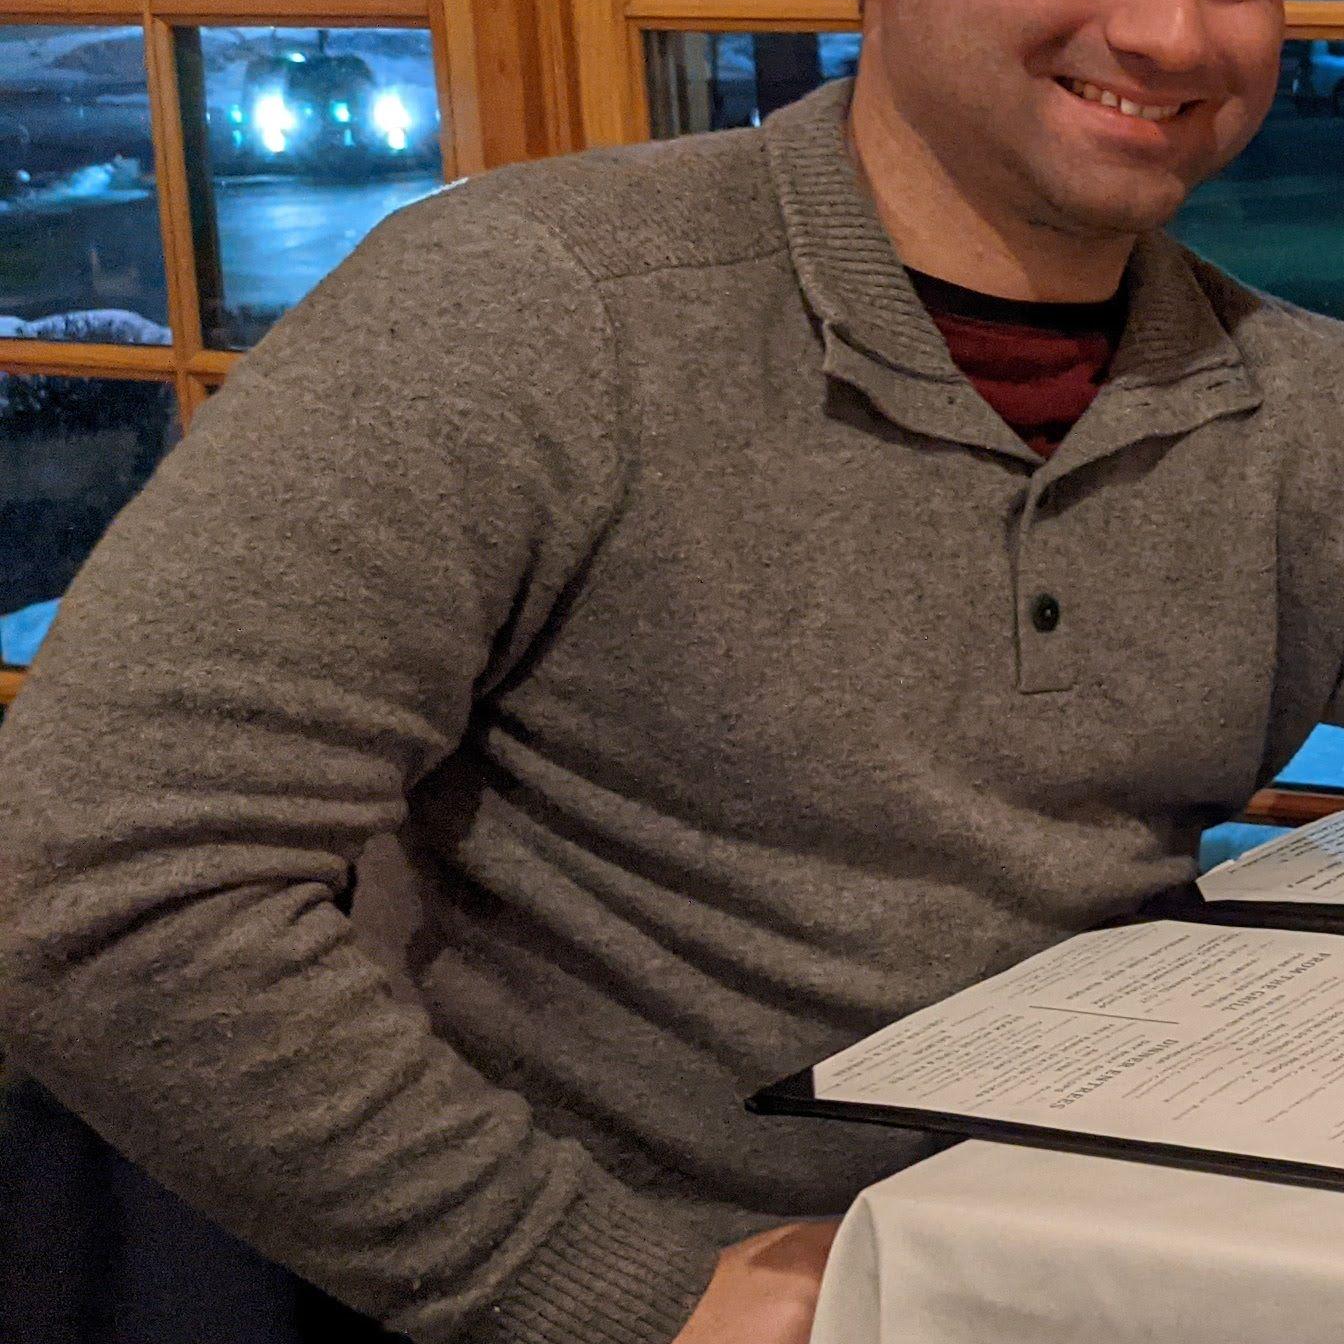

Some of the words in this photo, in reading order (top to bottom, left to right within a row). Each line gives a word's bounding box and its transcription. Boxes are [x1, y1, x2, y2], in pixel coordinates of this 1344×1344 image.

[1291, 952, 1329, 973] FROM
[1262, 974, 1293, 989] THE
[1221, 990, 1265, 1012] GRILL
[1119, 1038, 1178, 1068] DINNER
[1049, 1069, 1121, 1109] ENTREES
